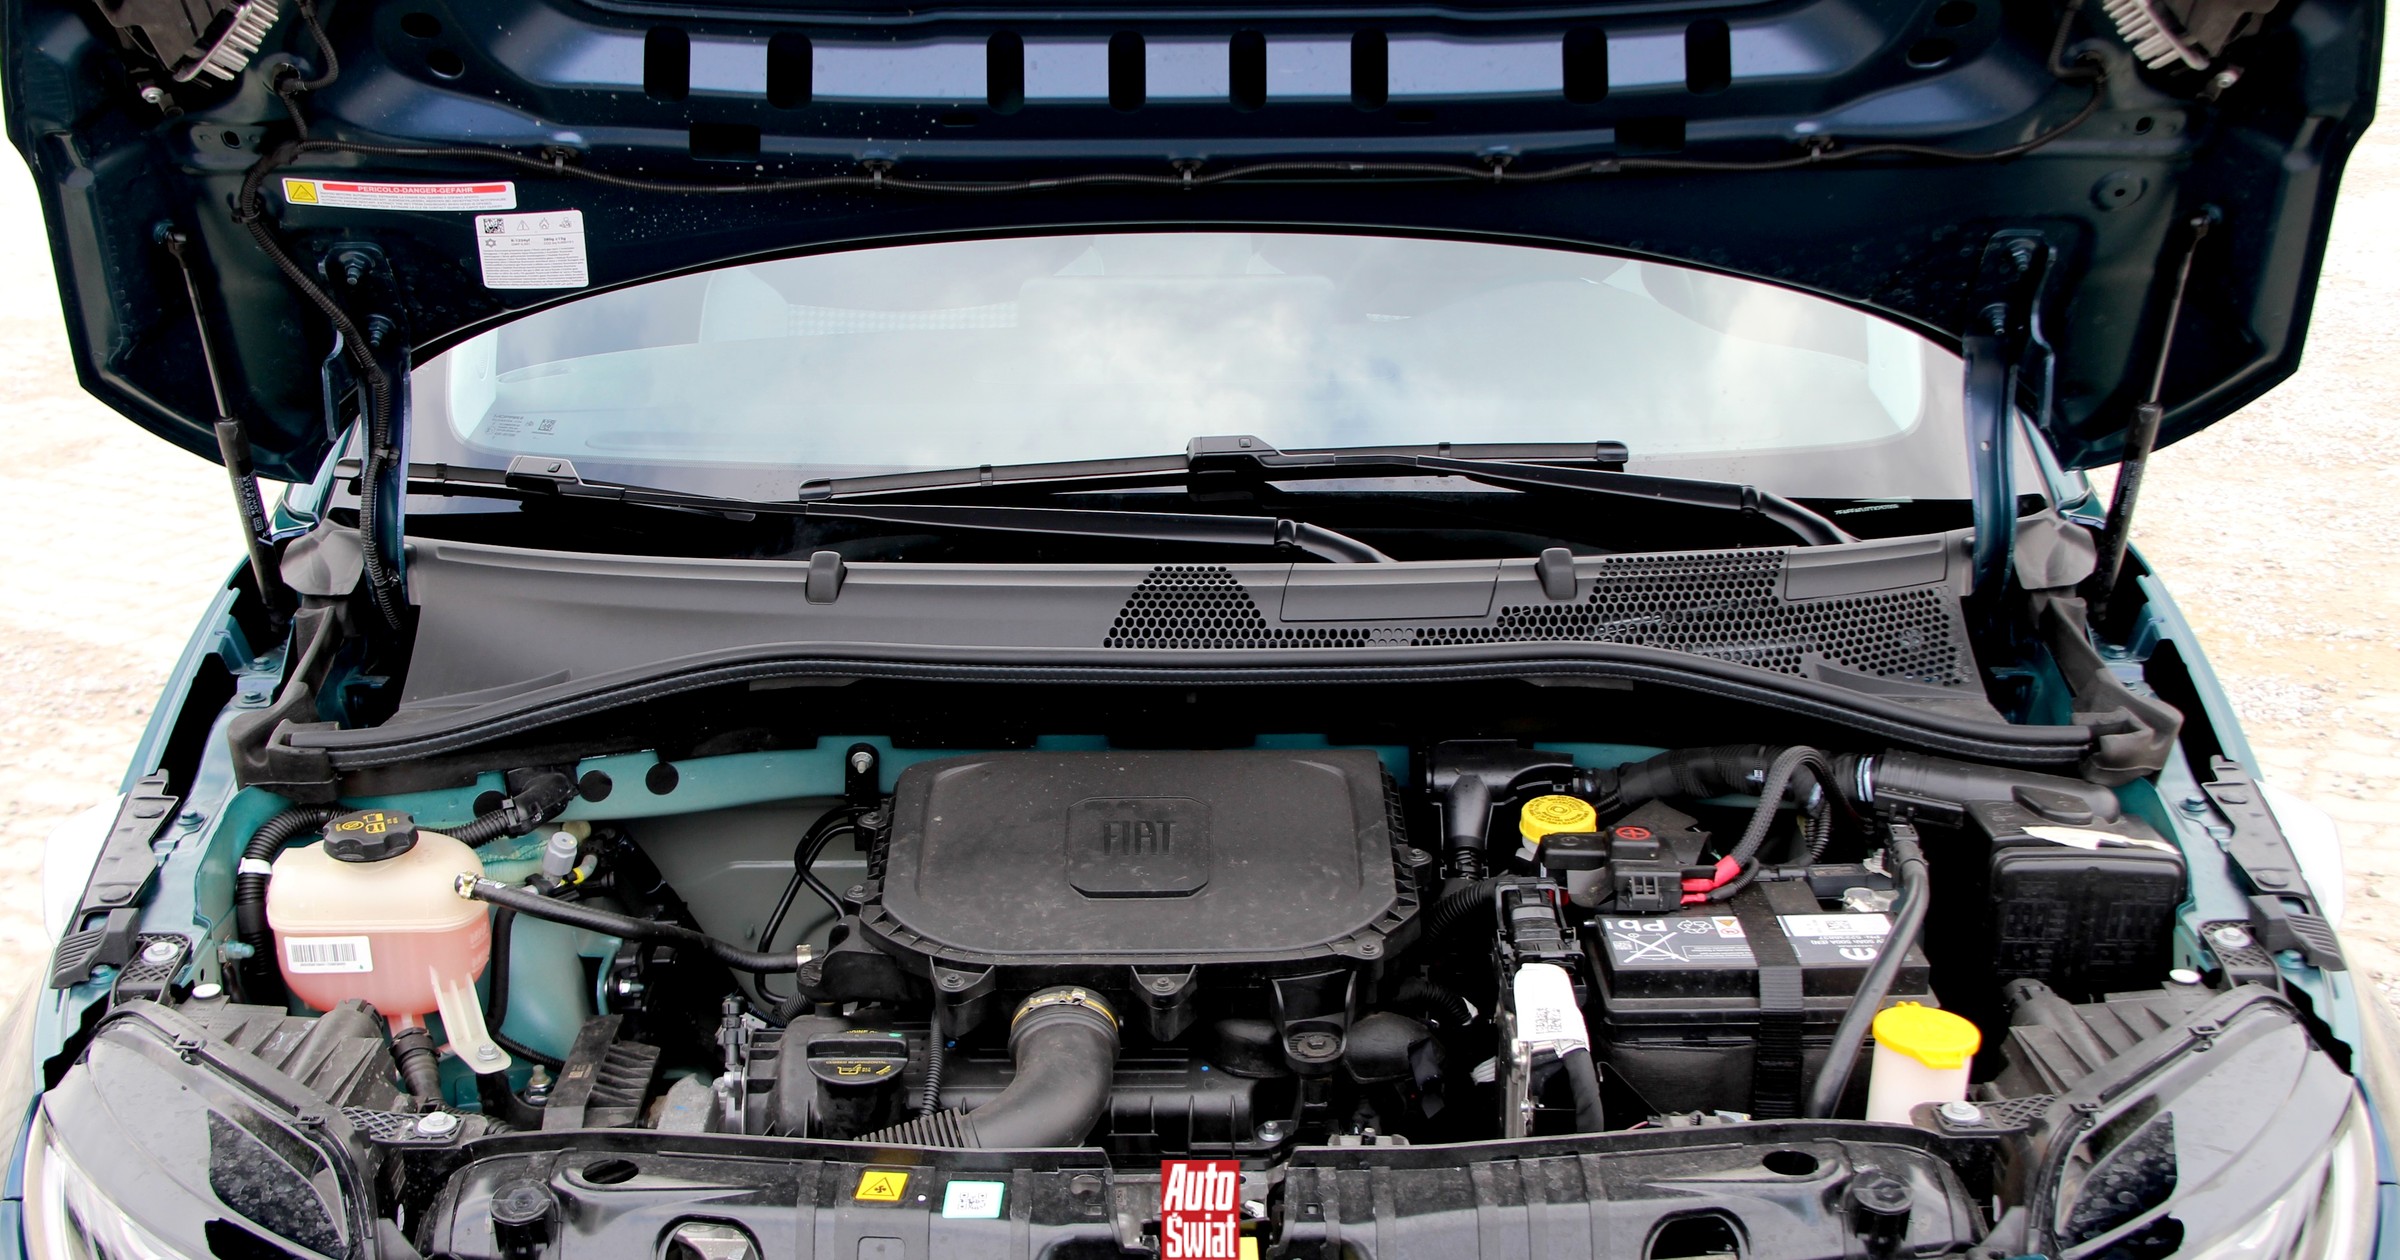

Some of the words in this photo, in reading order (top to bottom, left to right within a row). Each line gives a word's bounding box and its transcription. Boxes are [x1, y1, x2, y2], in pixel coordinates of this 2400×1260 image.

[357, 185, 474, 194] PERICOLO-DANGER-GEFAHR
[1103, 820, 1177, 856] FIAT
[1618, 919, 1668, 932] Pb
